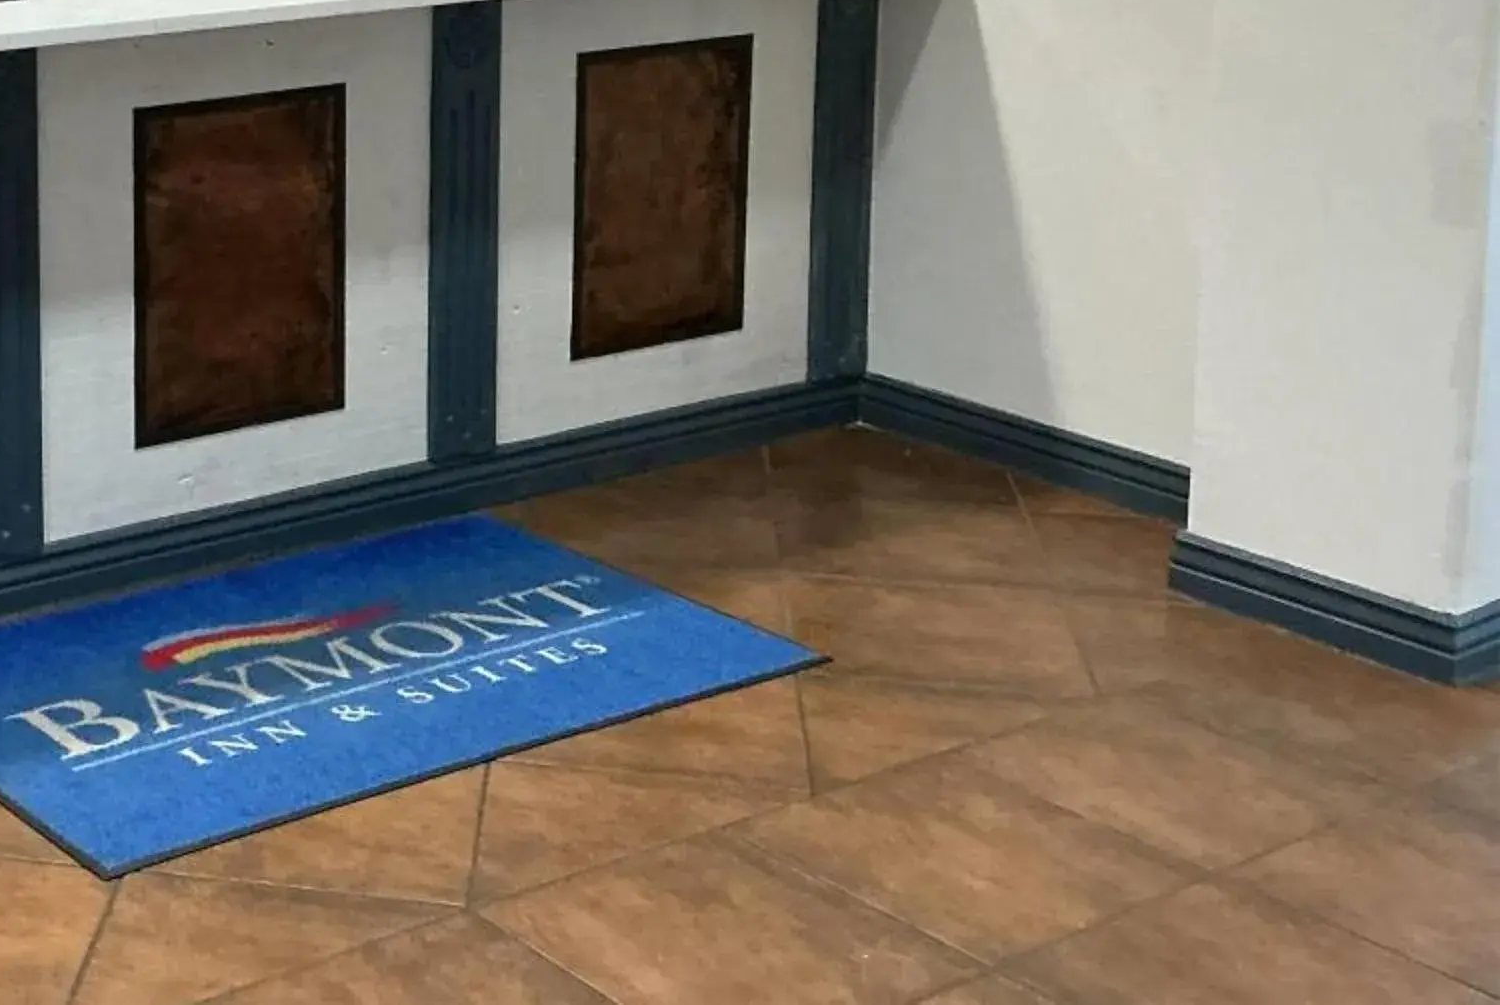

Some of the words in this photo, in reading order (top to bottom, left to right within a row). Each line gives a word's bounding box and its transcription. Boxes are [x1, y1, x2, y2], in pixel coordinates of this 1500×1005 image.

[177, 718, 307, 766] INN
[331, 703, 383, 723] &
[397, 637, 608, 704] SUITES
